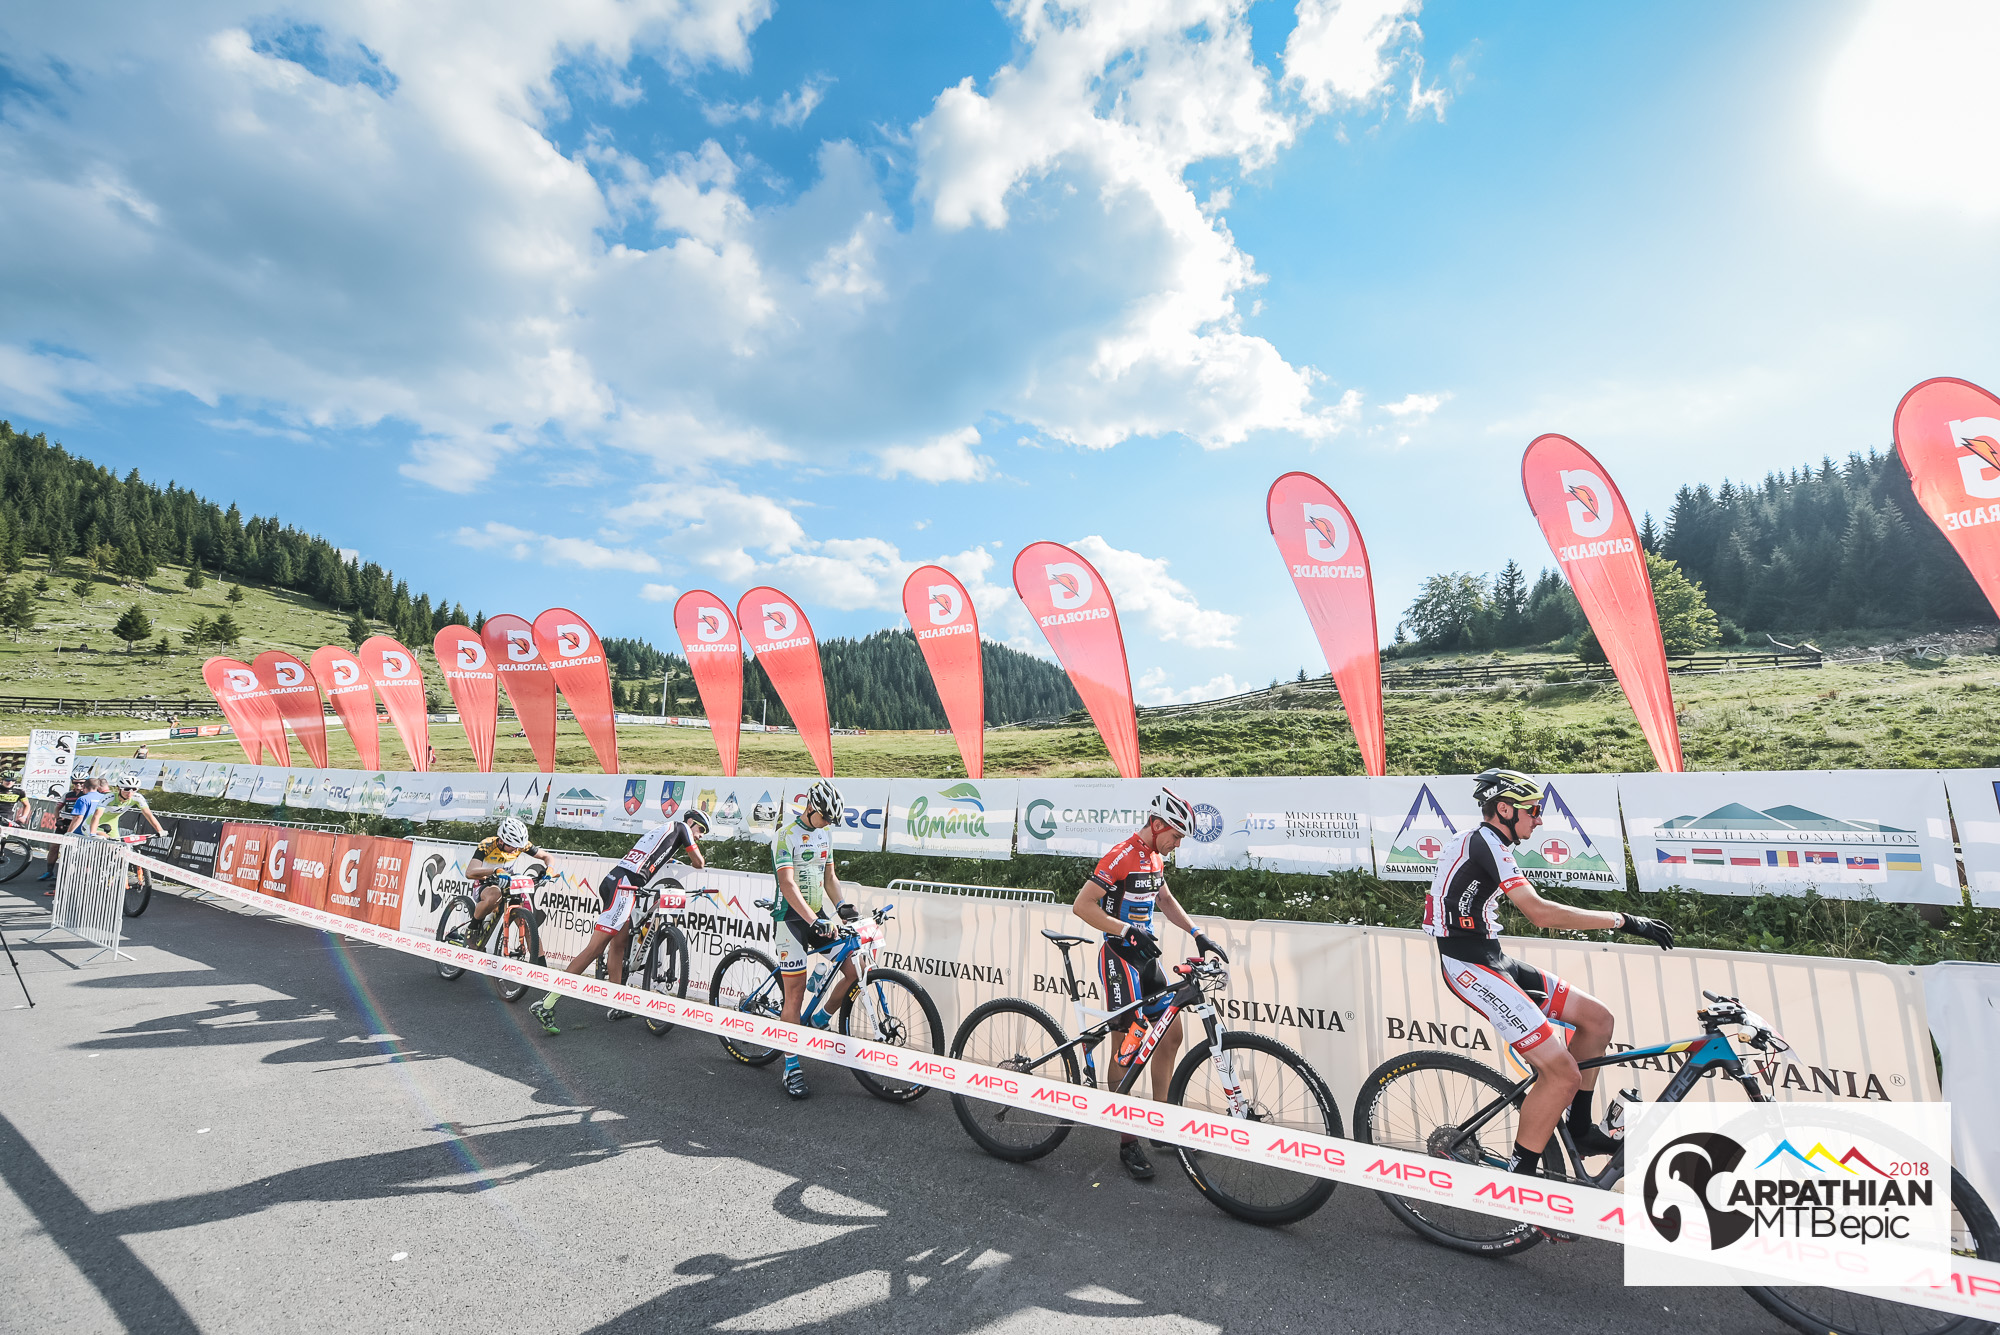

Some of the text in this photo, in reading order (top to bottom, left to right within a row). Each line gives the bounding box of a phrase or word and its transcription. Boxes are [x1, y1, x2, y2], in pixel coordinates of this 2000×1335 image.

[329, 786, 350, 799] FRC
[835, 808, 882, 829] RC
[907, 796, 989, 841] România
[1062, 808, 1149, 825] CARPATHI
[1285, 811, 1359, 821] MINISTERUL
[1065, 826, 1096, 834] European
[1099, 826, 1130, 834] Wilderness
[1245, 819, 1276, 831] MTS
[1300, 829, 1360, 839] SPORTULUI
[1654, 830, 1918, 843] CARPATHIAN CONVENTION
[220, 835, 237, 871] G
[268, 840, 289, 880] G
[339, 849, 362, 893] G
[1386, 864, 1437, 873] SALVAMONT
[1522, 869, 1614, 882] VAMONT ROMÂNIA
[664, 896, 682, 906] 130
[361, 927, 375, 936] MPG
[395, 936, 411, 947] MPG
[434, 946, 452, 957] MPG
[455, 952, 474, 963] MPG
[478, 958, 498, 969] MPG
[502, 963, 522, 976] MPG
[780, 959, 803, 968] TROM
[883, 952, 1004, 985] TRANSILVANIA
[527, 970, 549, 982] MPG
[554, 976, 578, 990] MPG
[582, 983, 608, 997] MPG
[1033, 974, 1099, 1000] BANCA
[613, 991, 641, 1005] MPG
[646, 999, 676, 1014] MPG
[682, 1007, 713, 1023] MPG
[1181, 996, 1345, 1032] NSILVANIA
[1471, 982, 1528, 1034] CARCOVER
[721, 1017, 754, 1032] MPG
[762, 1026, 798, 1043] MPG
[1139, 1009, 1175, 1062] CUBE
[1386, 1017, 1492, 1051] BANCA
[1520, 1034, 1539, 1048] ABUS
[728, 1045, 749, 1062] MAXXIS
[806, 1037, 846, 1055] MPG
[855, 1048, 898, 1067] MPG
[908, 1060, 956, 1080] MPG
[1379, 1062, 1417, 1085] MAXXIS
[966, 1073, 1018, 1094] MPG
[1031, 1087, 1088, 1110] MPG
[1101, 1103, 1165, 1127] MPG
[1180, 1120, 1250, 1146] MPG
[1266, 1138, 1346, 1166] MPG
[1364, 1159, 1453, 1190] MPG
[1474, 1182, 1574, 1215] MPG
